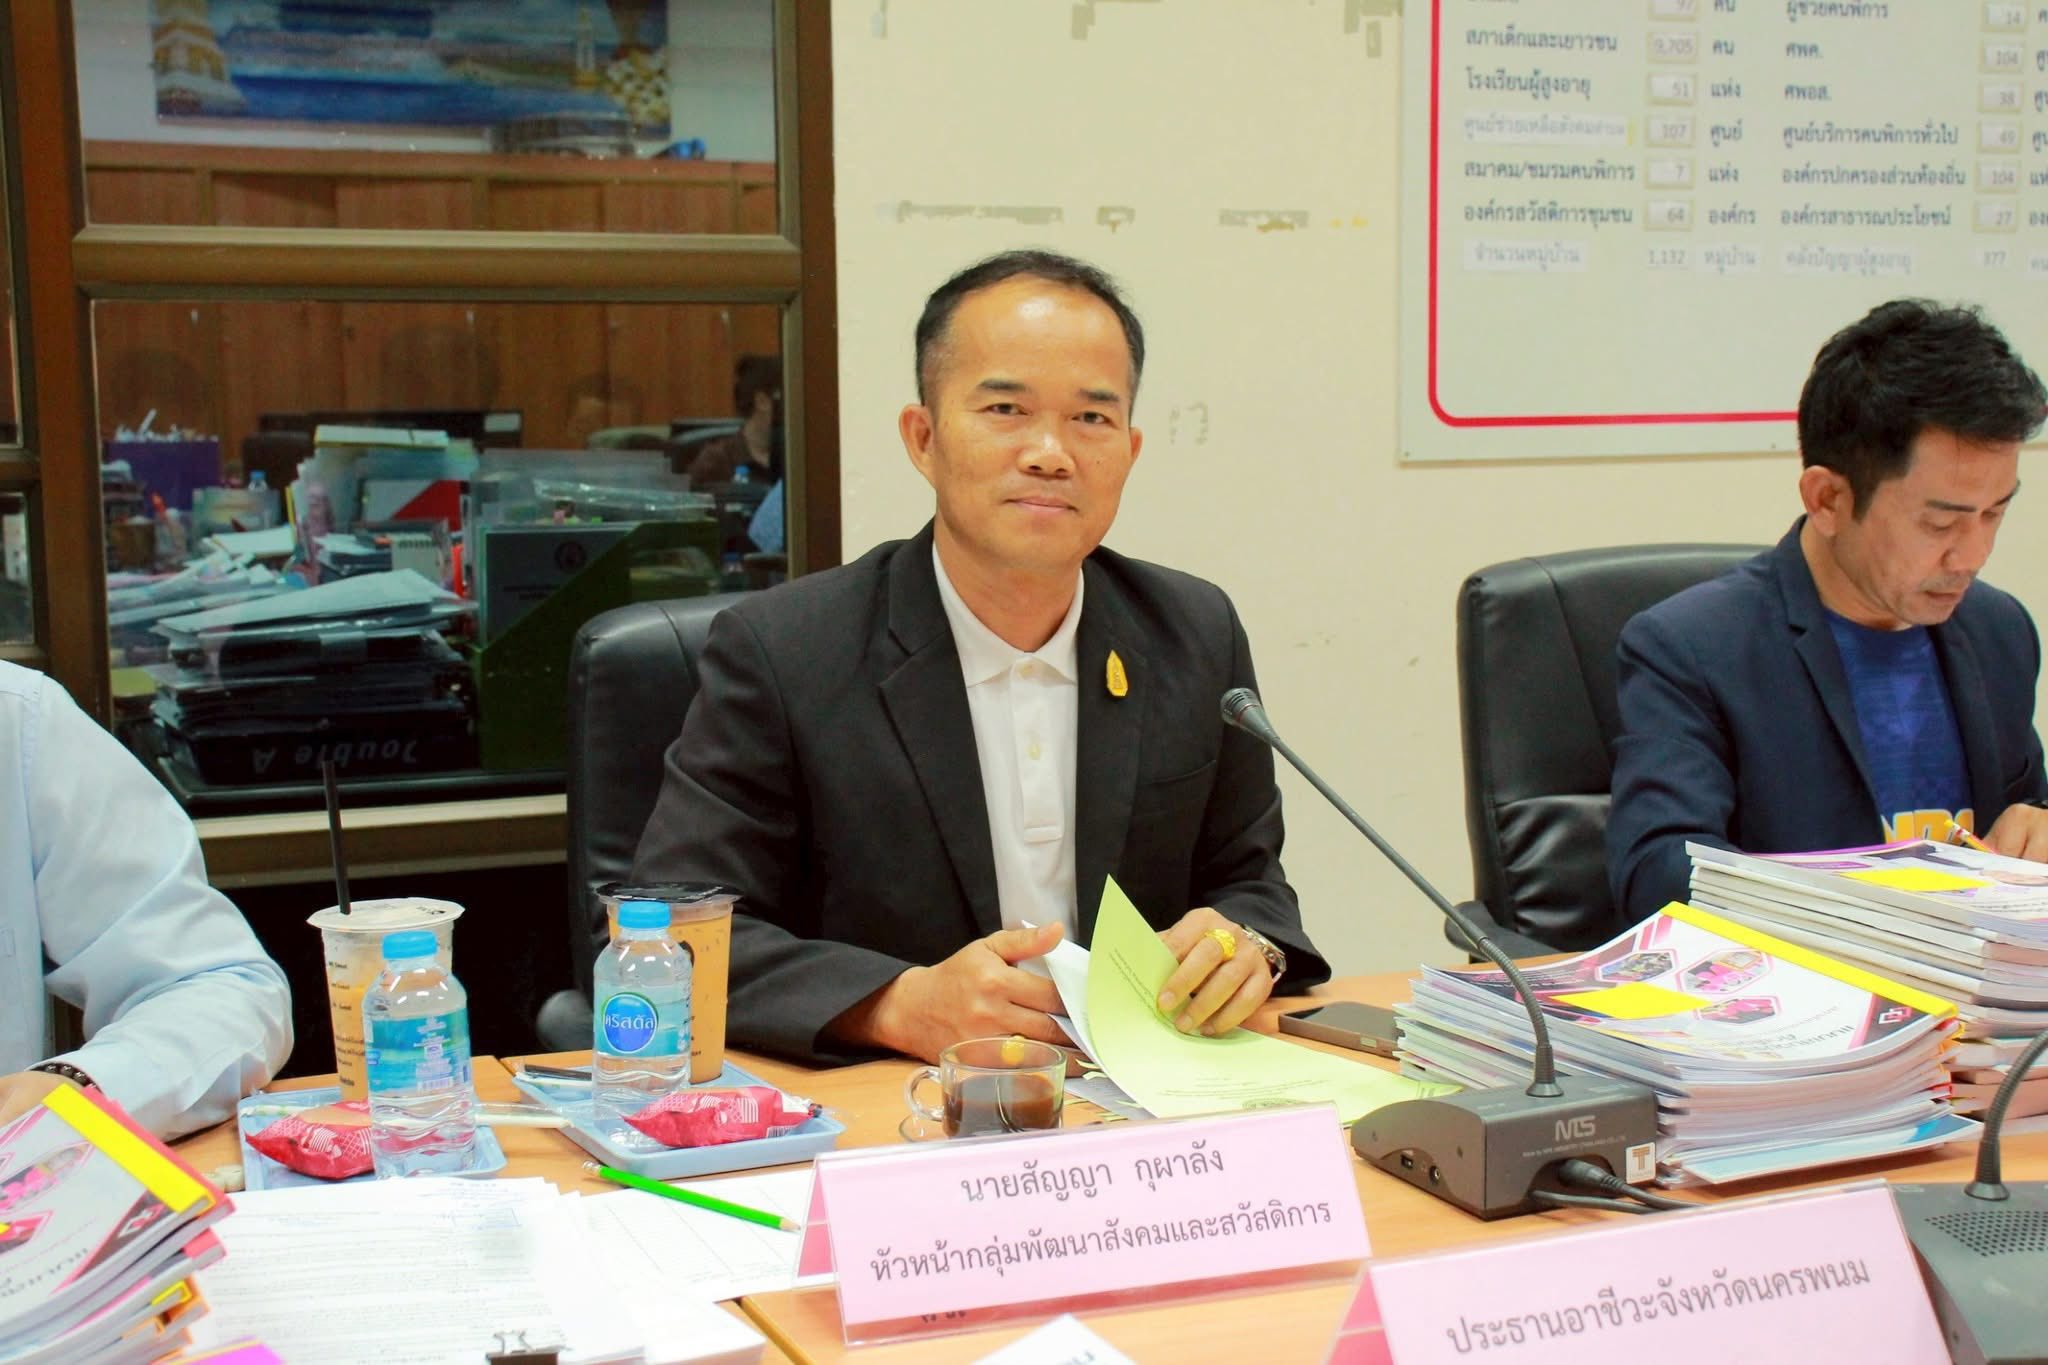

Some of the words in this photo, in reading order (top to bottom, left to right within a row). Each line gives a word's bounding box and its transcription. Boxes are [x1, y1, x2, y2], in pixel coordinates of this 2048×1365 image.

[1466, 23, 1618, 52] สภาเด็กและเยาวชน
[1712, 39, 1735, 56] คน
[1465, 65, 1591, 101] โรงเรียนผู้สูงอายุ
[1710, 78, 1742, 98] แห่ง
[1709, 118, 1743, 148] ศูนย์
[1782, 120, 1959, 149] ศูนย์บริการคนพิการทั่วไป
[1464, 158, 1635, 181] สมาคม/ชมรมคนพิการ
[1708, 162, 1739, 182] แห่ง
[1782, 161, 1966, 186] องค์กรปกครองส่วนท้องถิ่น
[1464, 198, 1633, 229] องค์กรสวัสดิการชุมชน
[1708, 202, 1756, 225] องค์กร
[1780, 203, 1952, 227] องค์กรสาธารณประโยชน์
[604, 1013, 655, 1030] คริสตัล
[960, 1159, 1113, 1202] นายสัญญา
[1134, 1139, 1224, 1192] กุผาลัง
[870, 1198, 1333, 1281] หัวหน้ากลุ่มพัฒนาสังคมและสวัสดิการ
[1446, 1258, 1872, 1355] ประธานอาชีวะจังหวัดนครพนม
